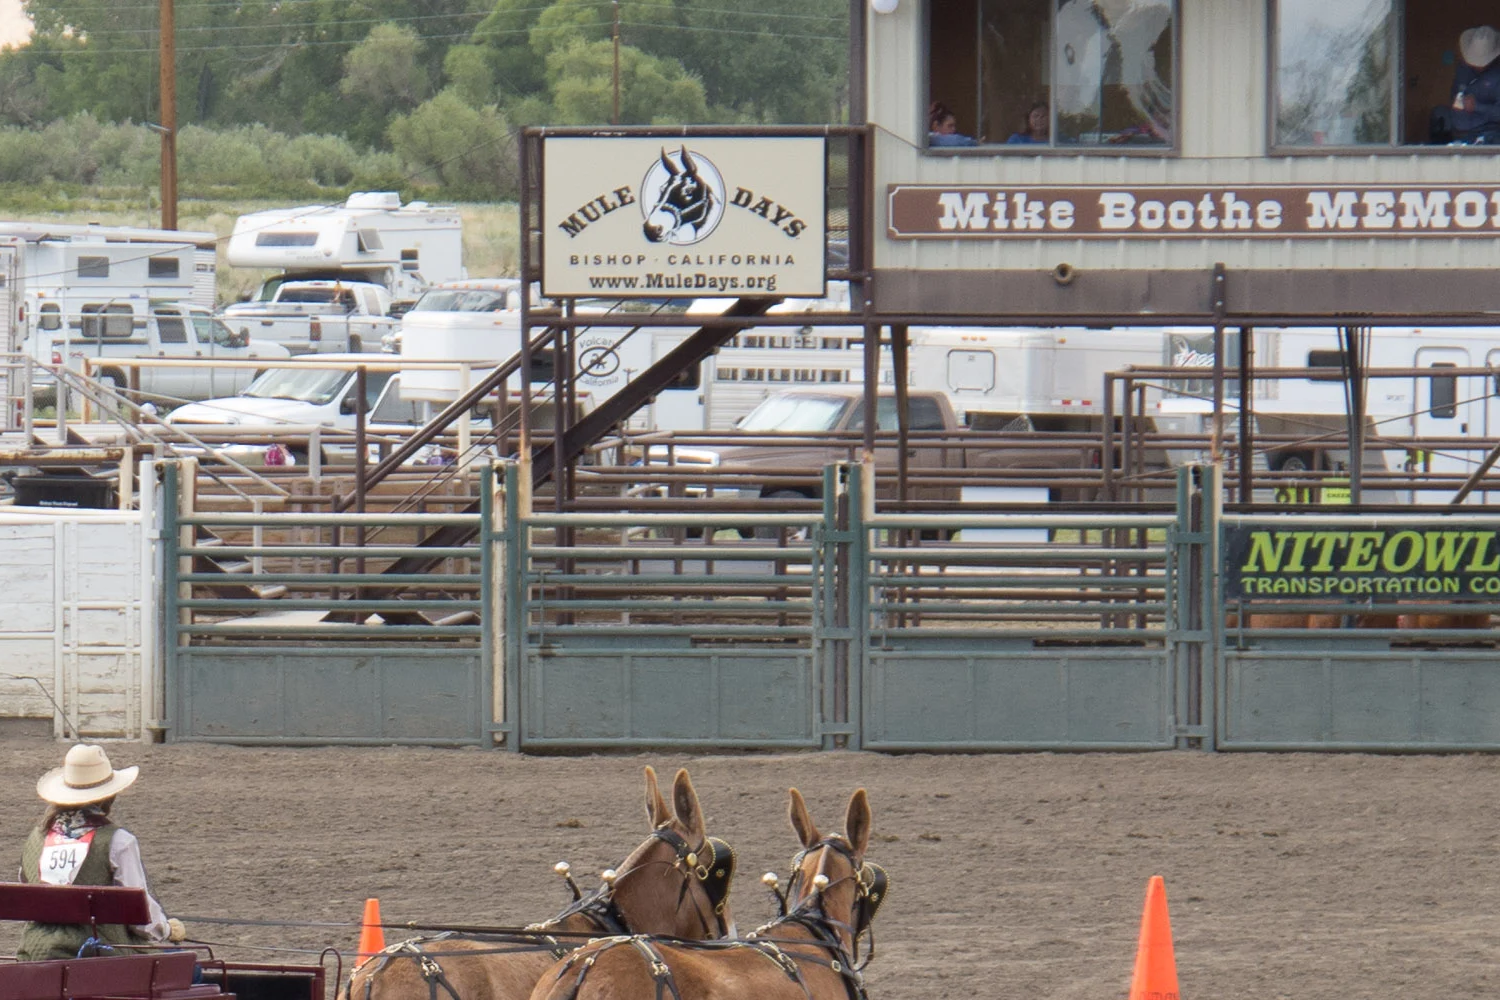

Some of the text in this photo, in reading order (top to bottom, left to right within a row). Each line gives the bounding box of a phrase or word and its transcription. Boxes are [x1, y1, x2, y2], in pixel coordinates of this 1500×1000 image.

[558, 185, 807, 240] MULE DAYS
[937, 190, 1500, 229] Mike Boothe MEMO
[570, 254, 796, 265] BISHOP CALIFORNIA
[589, 273, 777, 291] www.MuleDays.org
[1241, 531, 1500, 572] NITEOWL
[1241, 577, 1460, 594] TRANSPORTATION
[49, 848, 77, 870] 594
